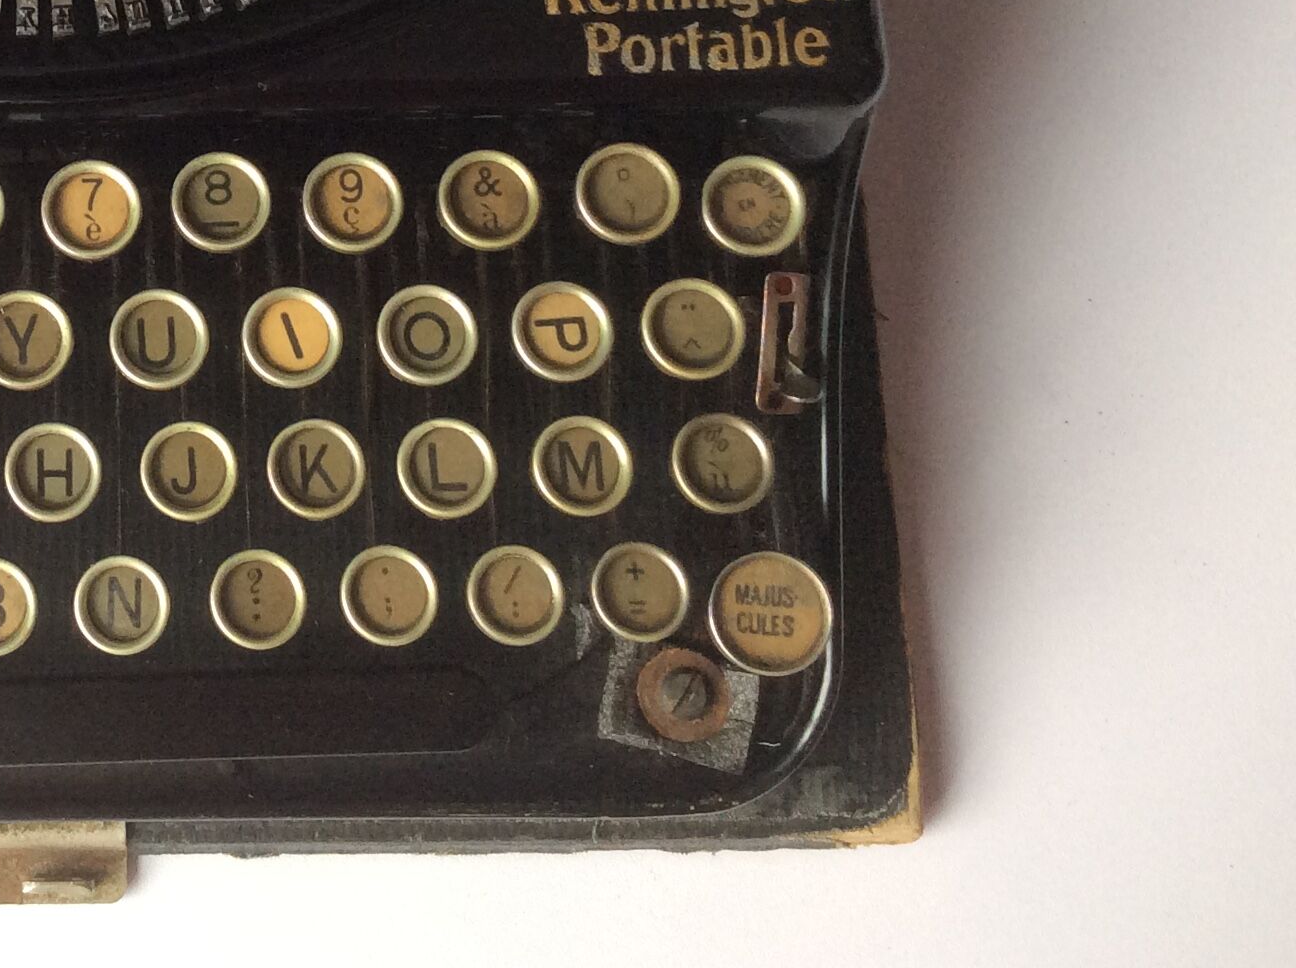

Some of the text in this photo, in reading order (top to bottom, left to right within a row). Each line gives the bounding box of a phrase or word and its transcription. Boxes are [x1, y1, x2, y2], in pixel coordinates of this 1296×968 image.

[583, 17, 830, 76] Portable
[81, 178, 103, 211] 7
[204, 170, 232, 206] 8
[338, 169, 363, 204] 9
[475, 166, 502, 197] &
[84, 215, 102, 240] è
[4, 313, 38, 365] Y
[137, 316, 175, 369] U
[281, 312, 303, 359] I
[405, 311, 450, 361] O
[534, 316, 589, 353] P
[37, 447, 74, 498] H
[171, 446, 196, 496] J
[299, 443, 338, 498] K
[428, 442, 468, 493] L
[557, 440, 604, 493] M
[107, 576, 143, 629] N
[247, 567, 263, 605] ?
[736, 611, 794, 637] CULES
